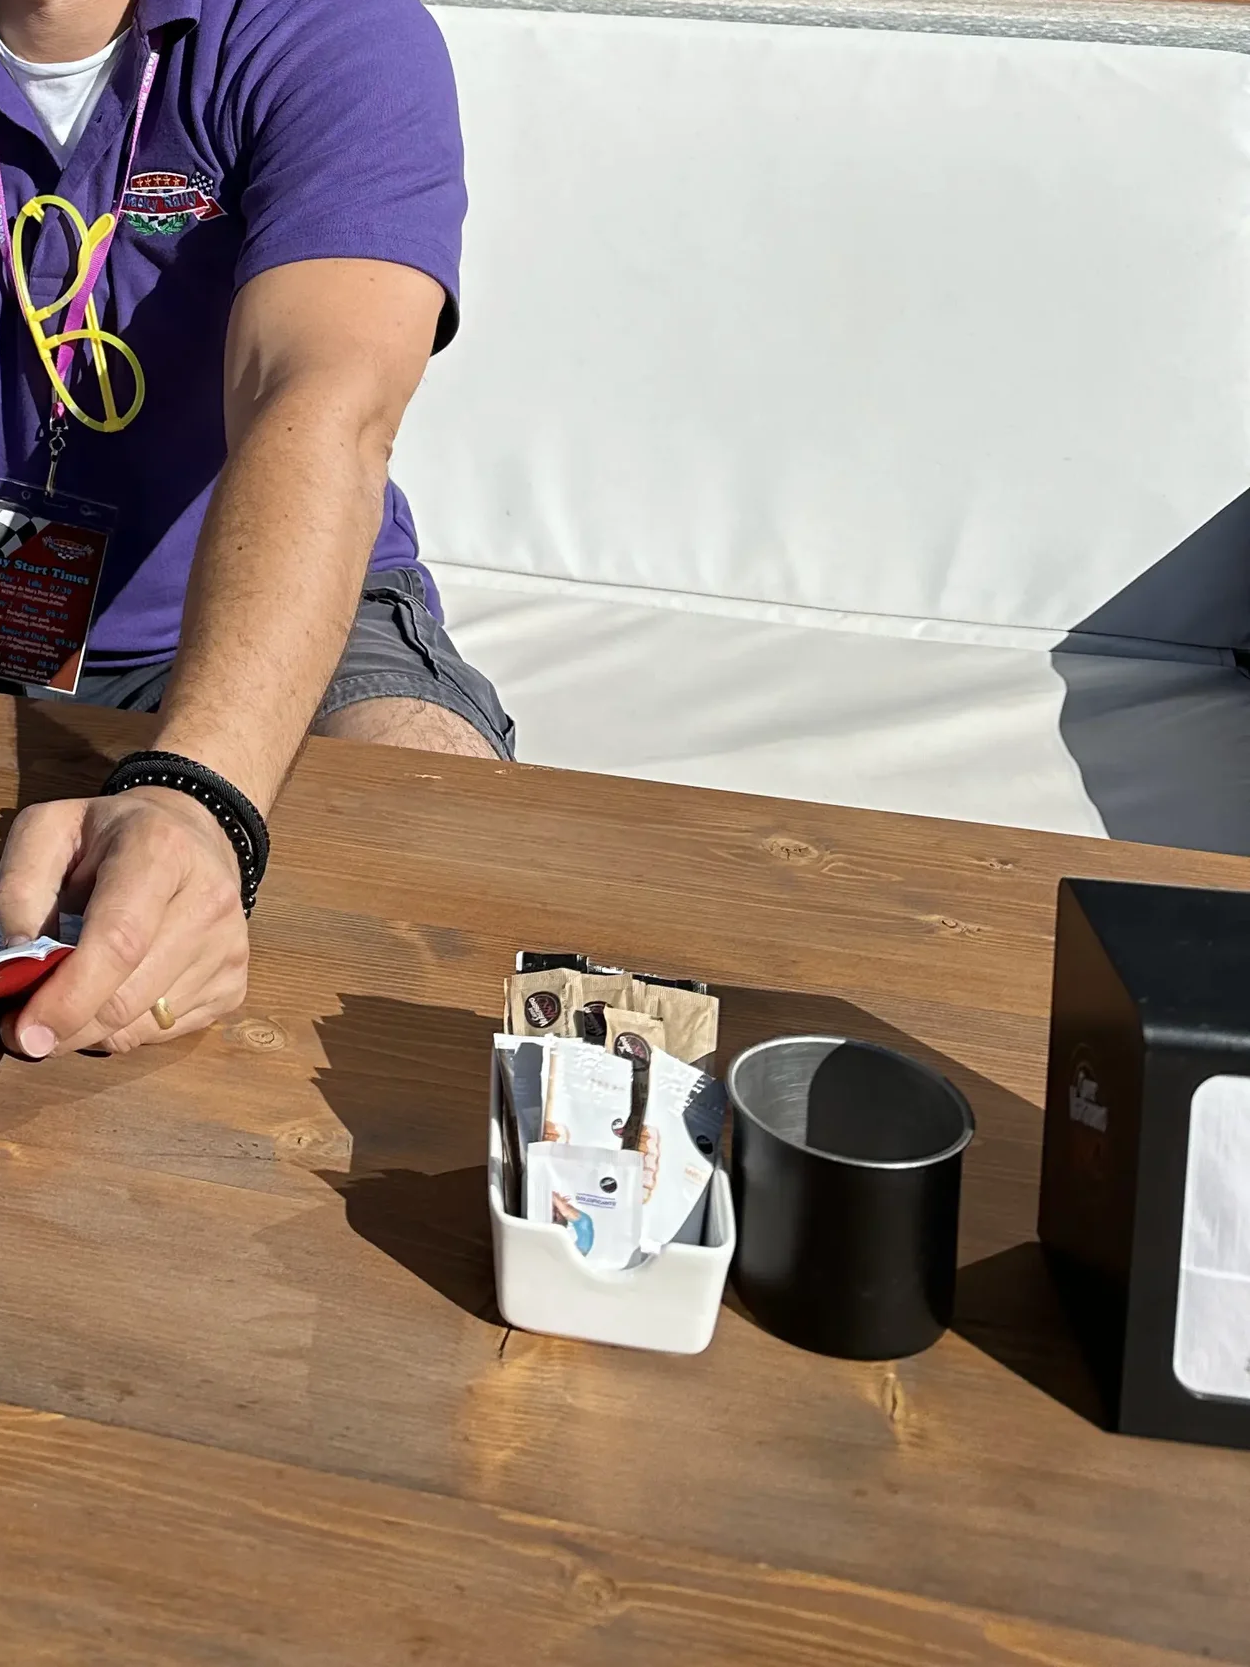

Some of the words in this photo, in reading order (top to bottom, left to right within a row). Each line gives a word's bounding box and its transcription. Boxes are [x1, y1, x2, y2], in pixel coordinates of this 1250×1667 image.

[163, 191, 197, 208] Rally
[14, 560, 48, 575] Start
[51, 568, 90, 585] Times
